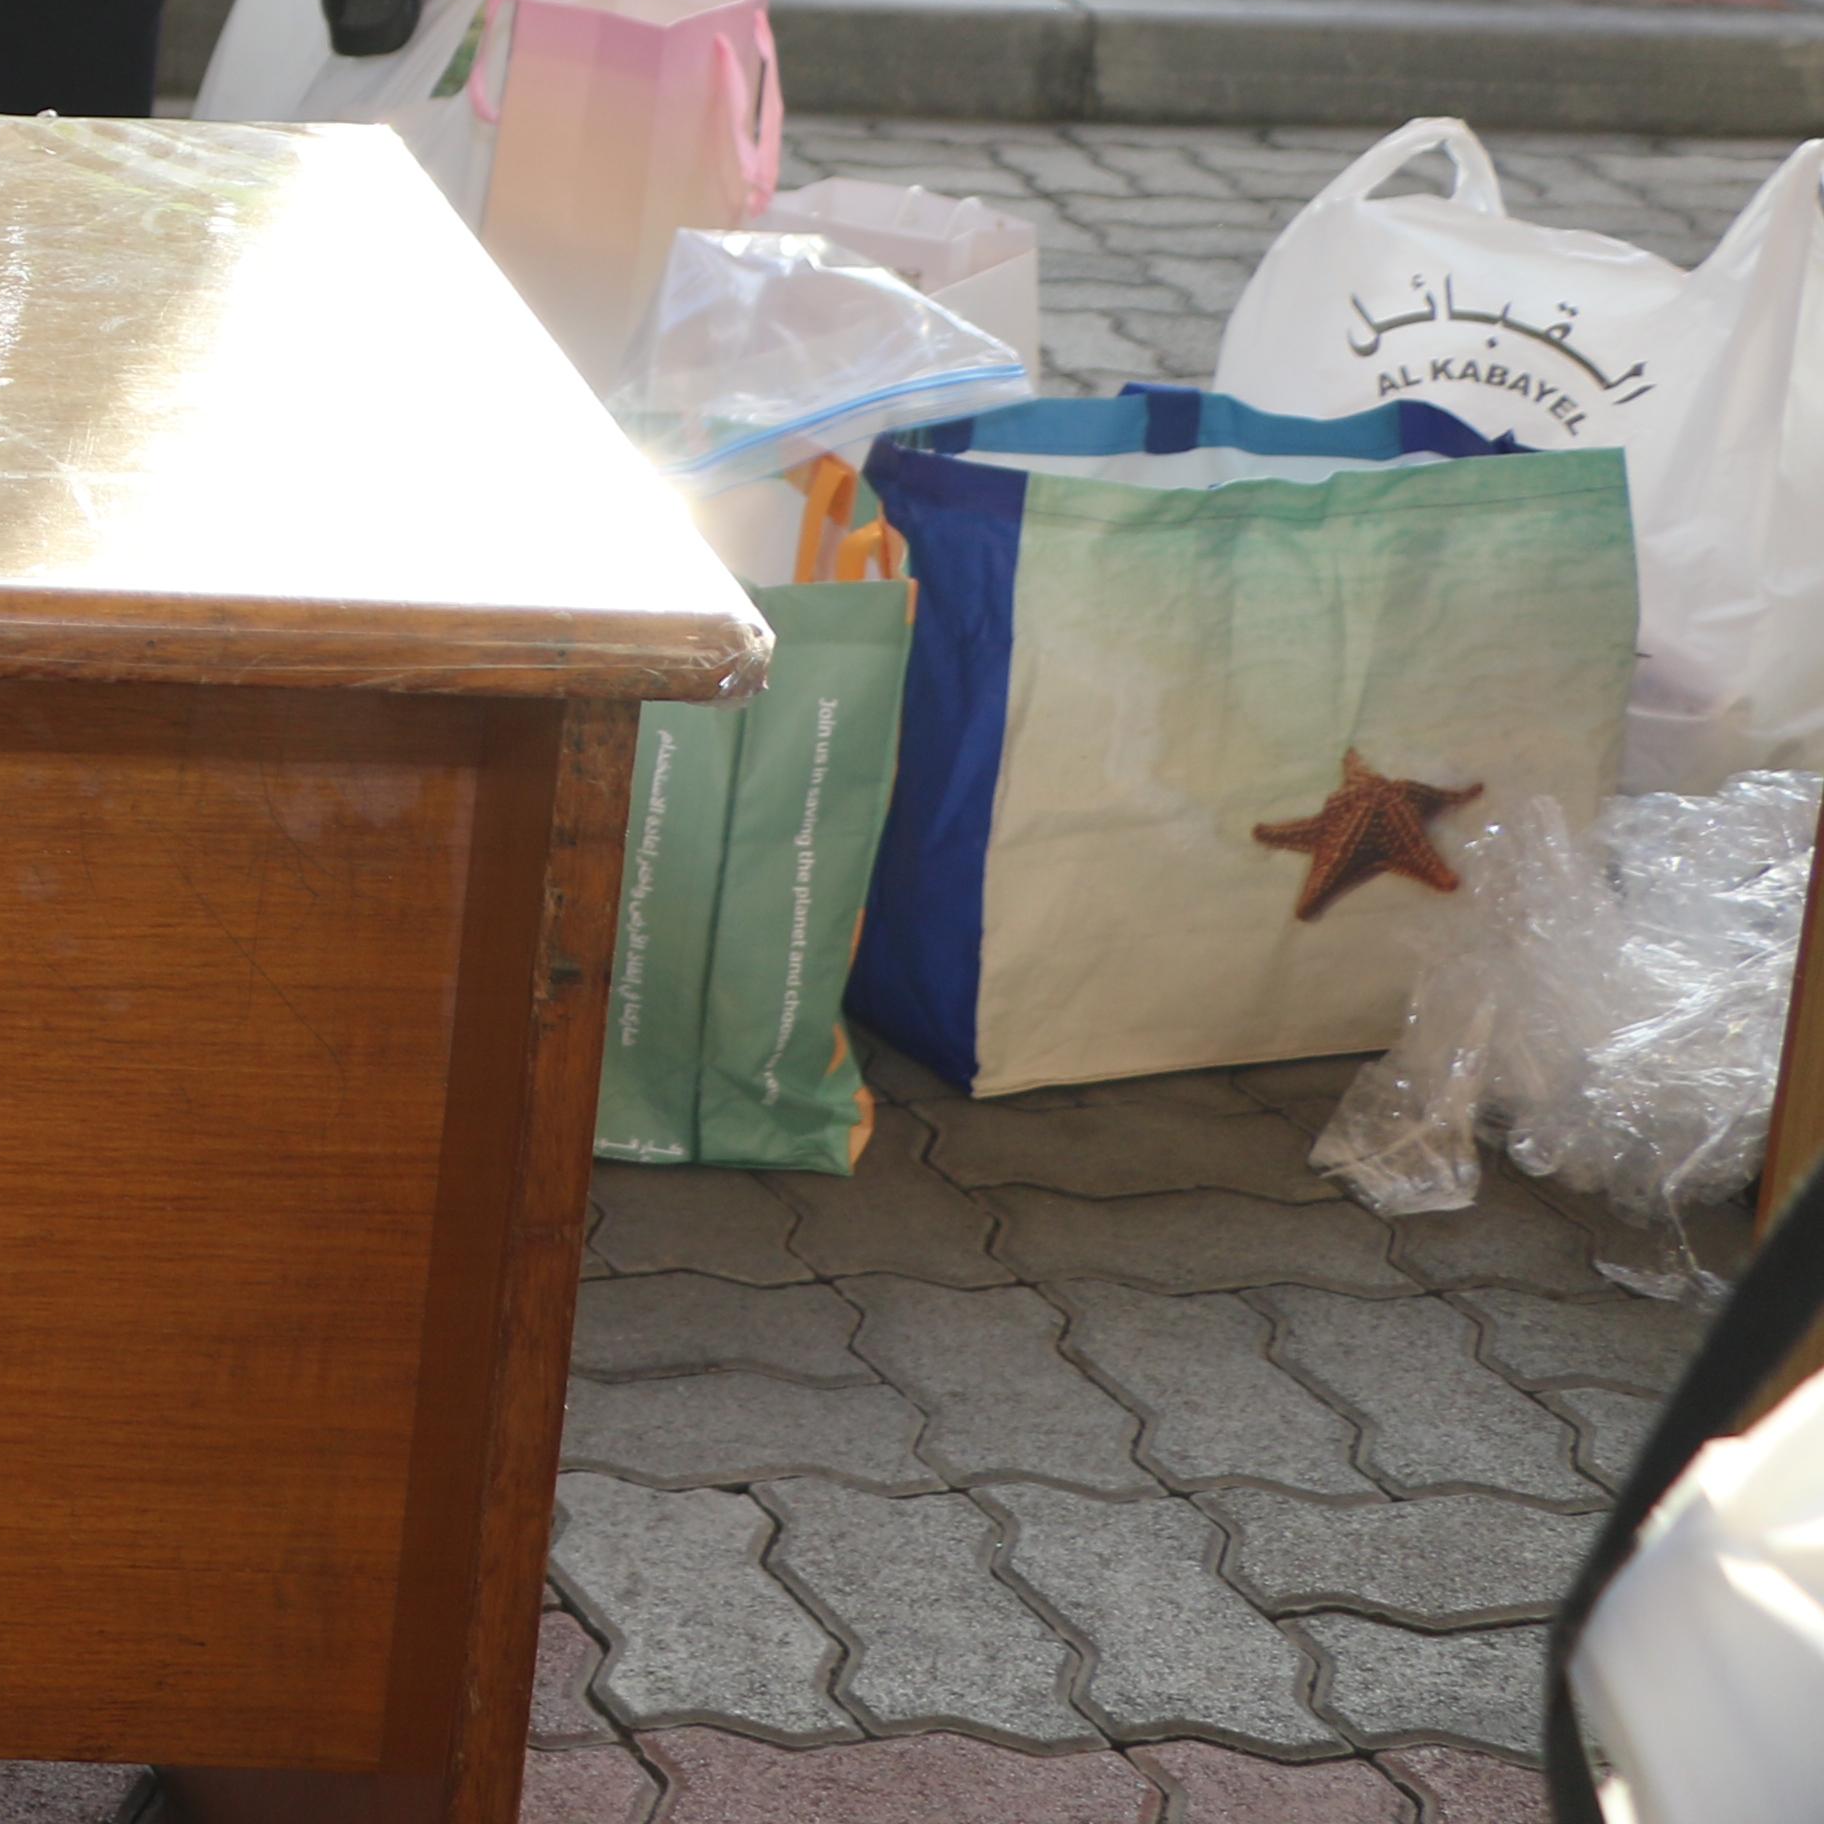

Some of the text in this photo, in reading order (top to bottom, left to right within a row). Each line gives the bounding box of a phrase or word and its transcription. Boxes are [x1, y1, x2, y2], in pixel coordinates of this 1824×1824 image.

[1348, 274, 1656, 406] القبائل
[1375, 356, 1590, 438] AL KABAYEL
[817, 697, 838, 739] Join
[815, 742, 832, 763] us
[809, 766, 829, 785] in
[794, 785, 821, 848] saving
[796, 850, 816, 884] the
[790, 886, 812, 947] planet
[786, 950, 803, 987] and
